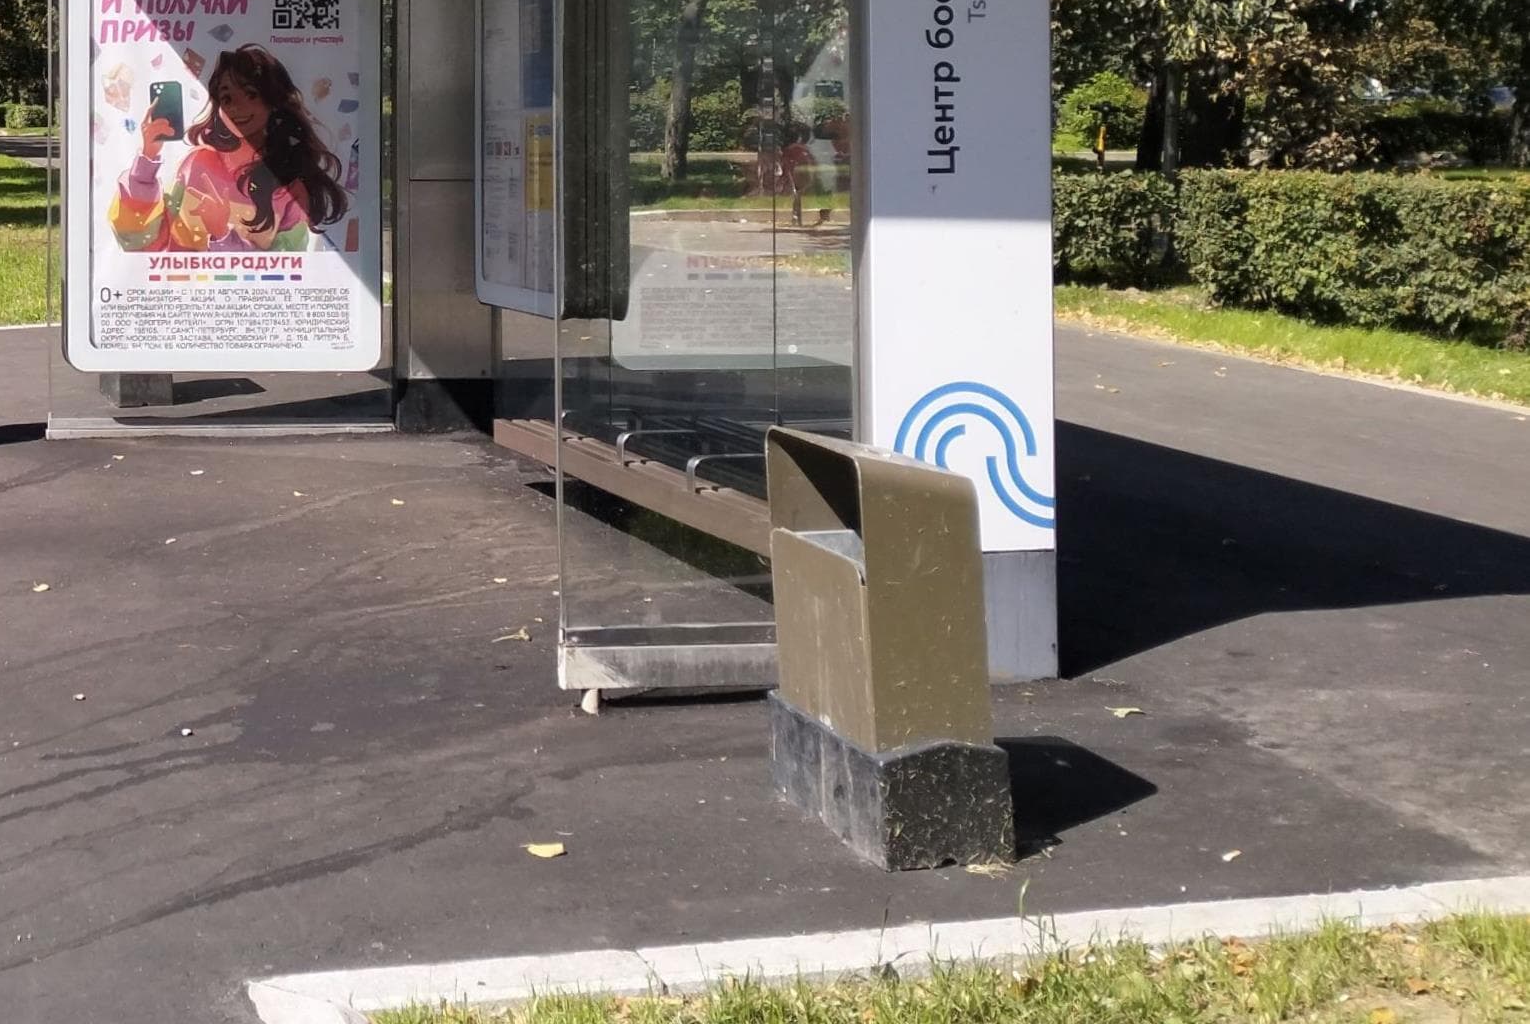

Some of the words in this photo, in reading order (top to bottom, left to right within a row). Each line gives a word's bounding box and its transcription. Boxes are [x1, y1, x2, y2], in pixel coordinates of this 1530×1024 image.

[100, 19, 195, 44] ПРИЗЫ
[927, 61, 961, 174] Центр
[100, 287, 123, 303] 0+
